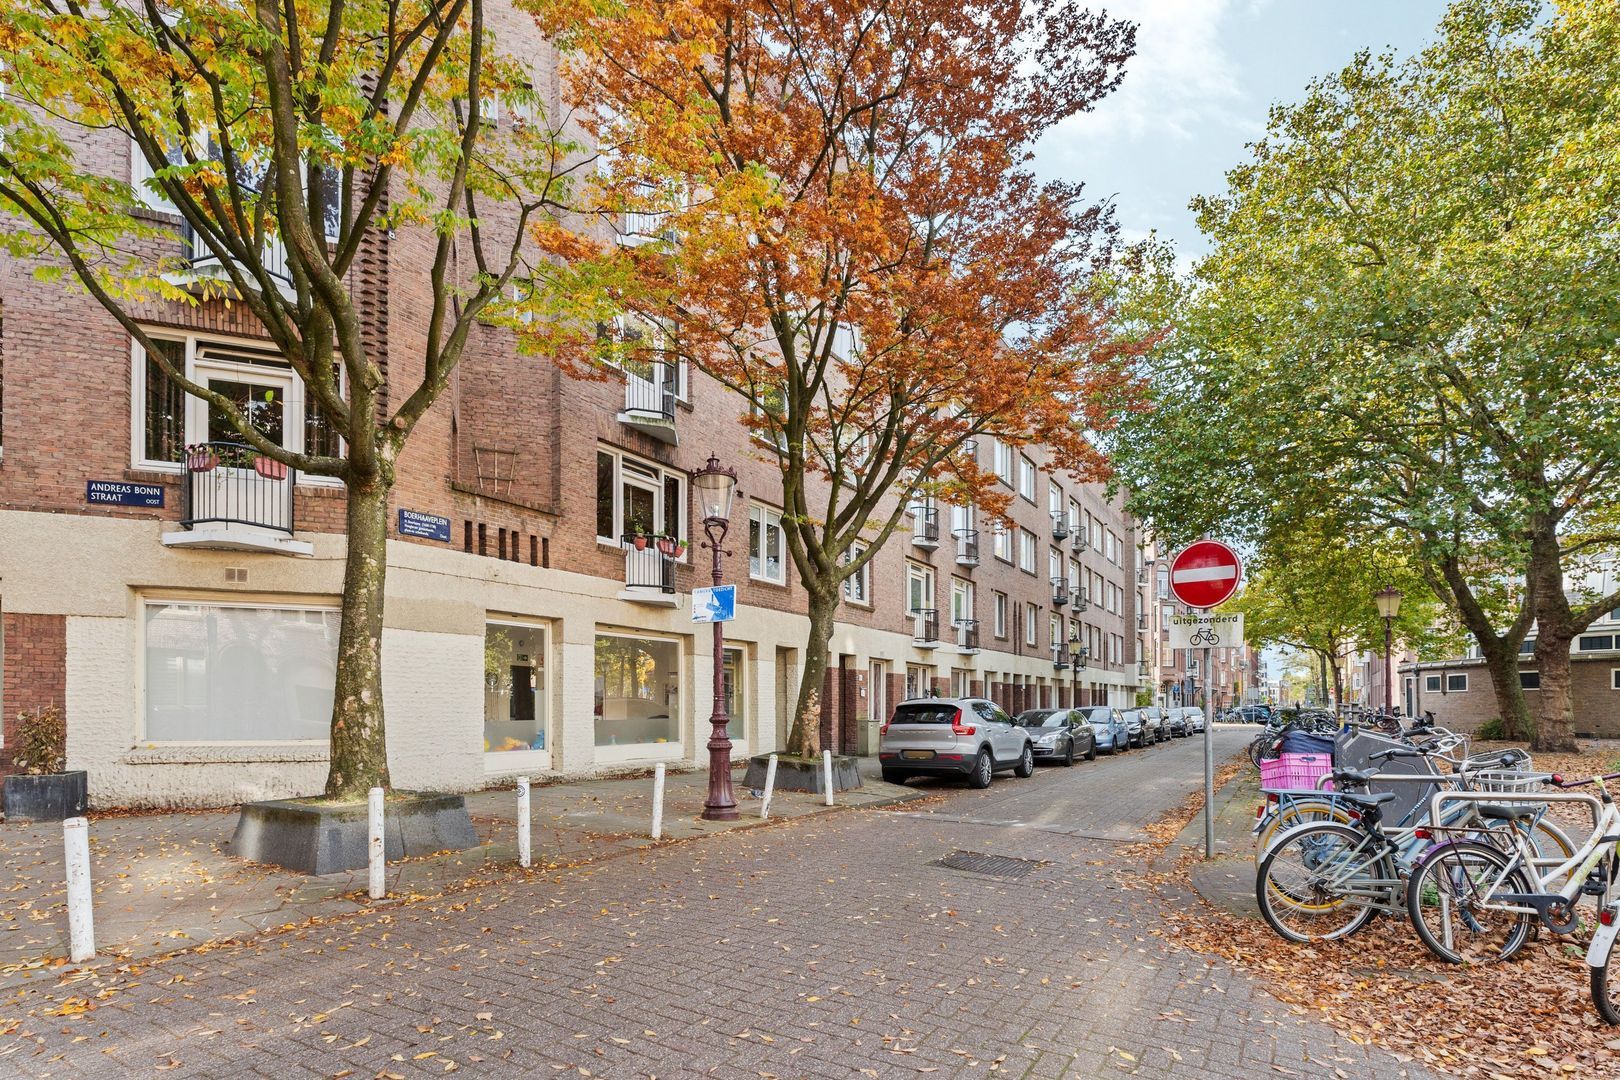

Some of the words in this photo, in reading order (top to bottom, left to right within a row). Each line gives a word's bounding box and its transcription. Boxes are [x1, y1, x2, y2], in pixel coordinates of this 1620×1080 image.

[91, 483, 131, 493] ANDREAS
[134, 486, 160, 496] BONN
[91, 492, 123, 502] STRAAT
[403, 510, 448, 526] BOERHAAVEPLEIN
[1173, 615, 1238, 627] uitgezonderd
